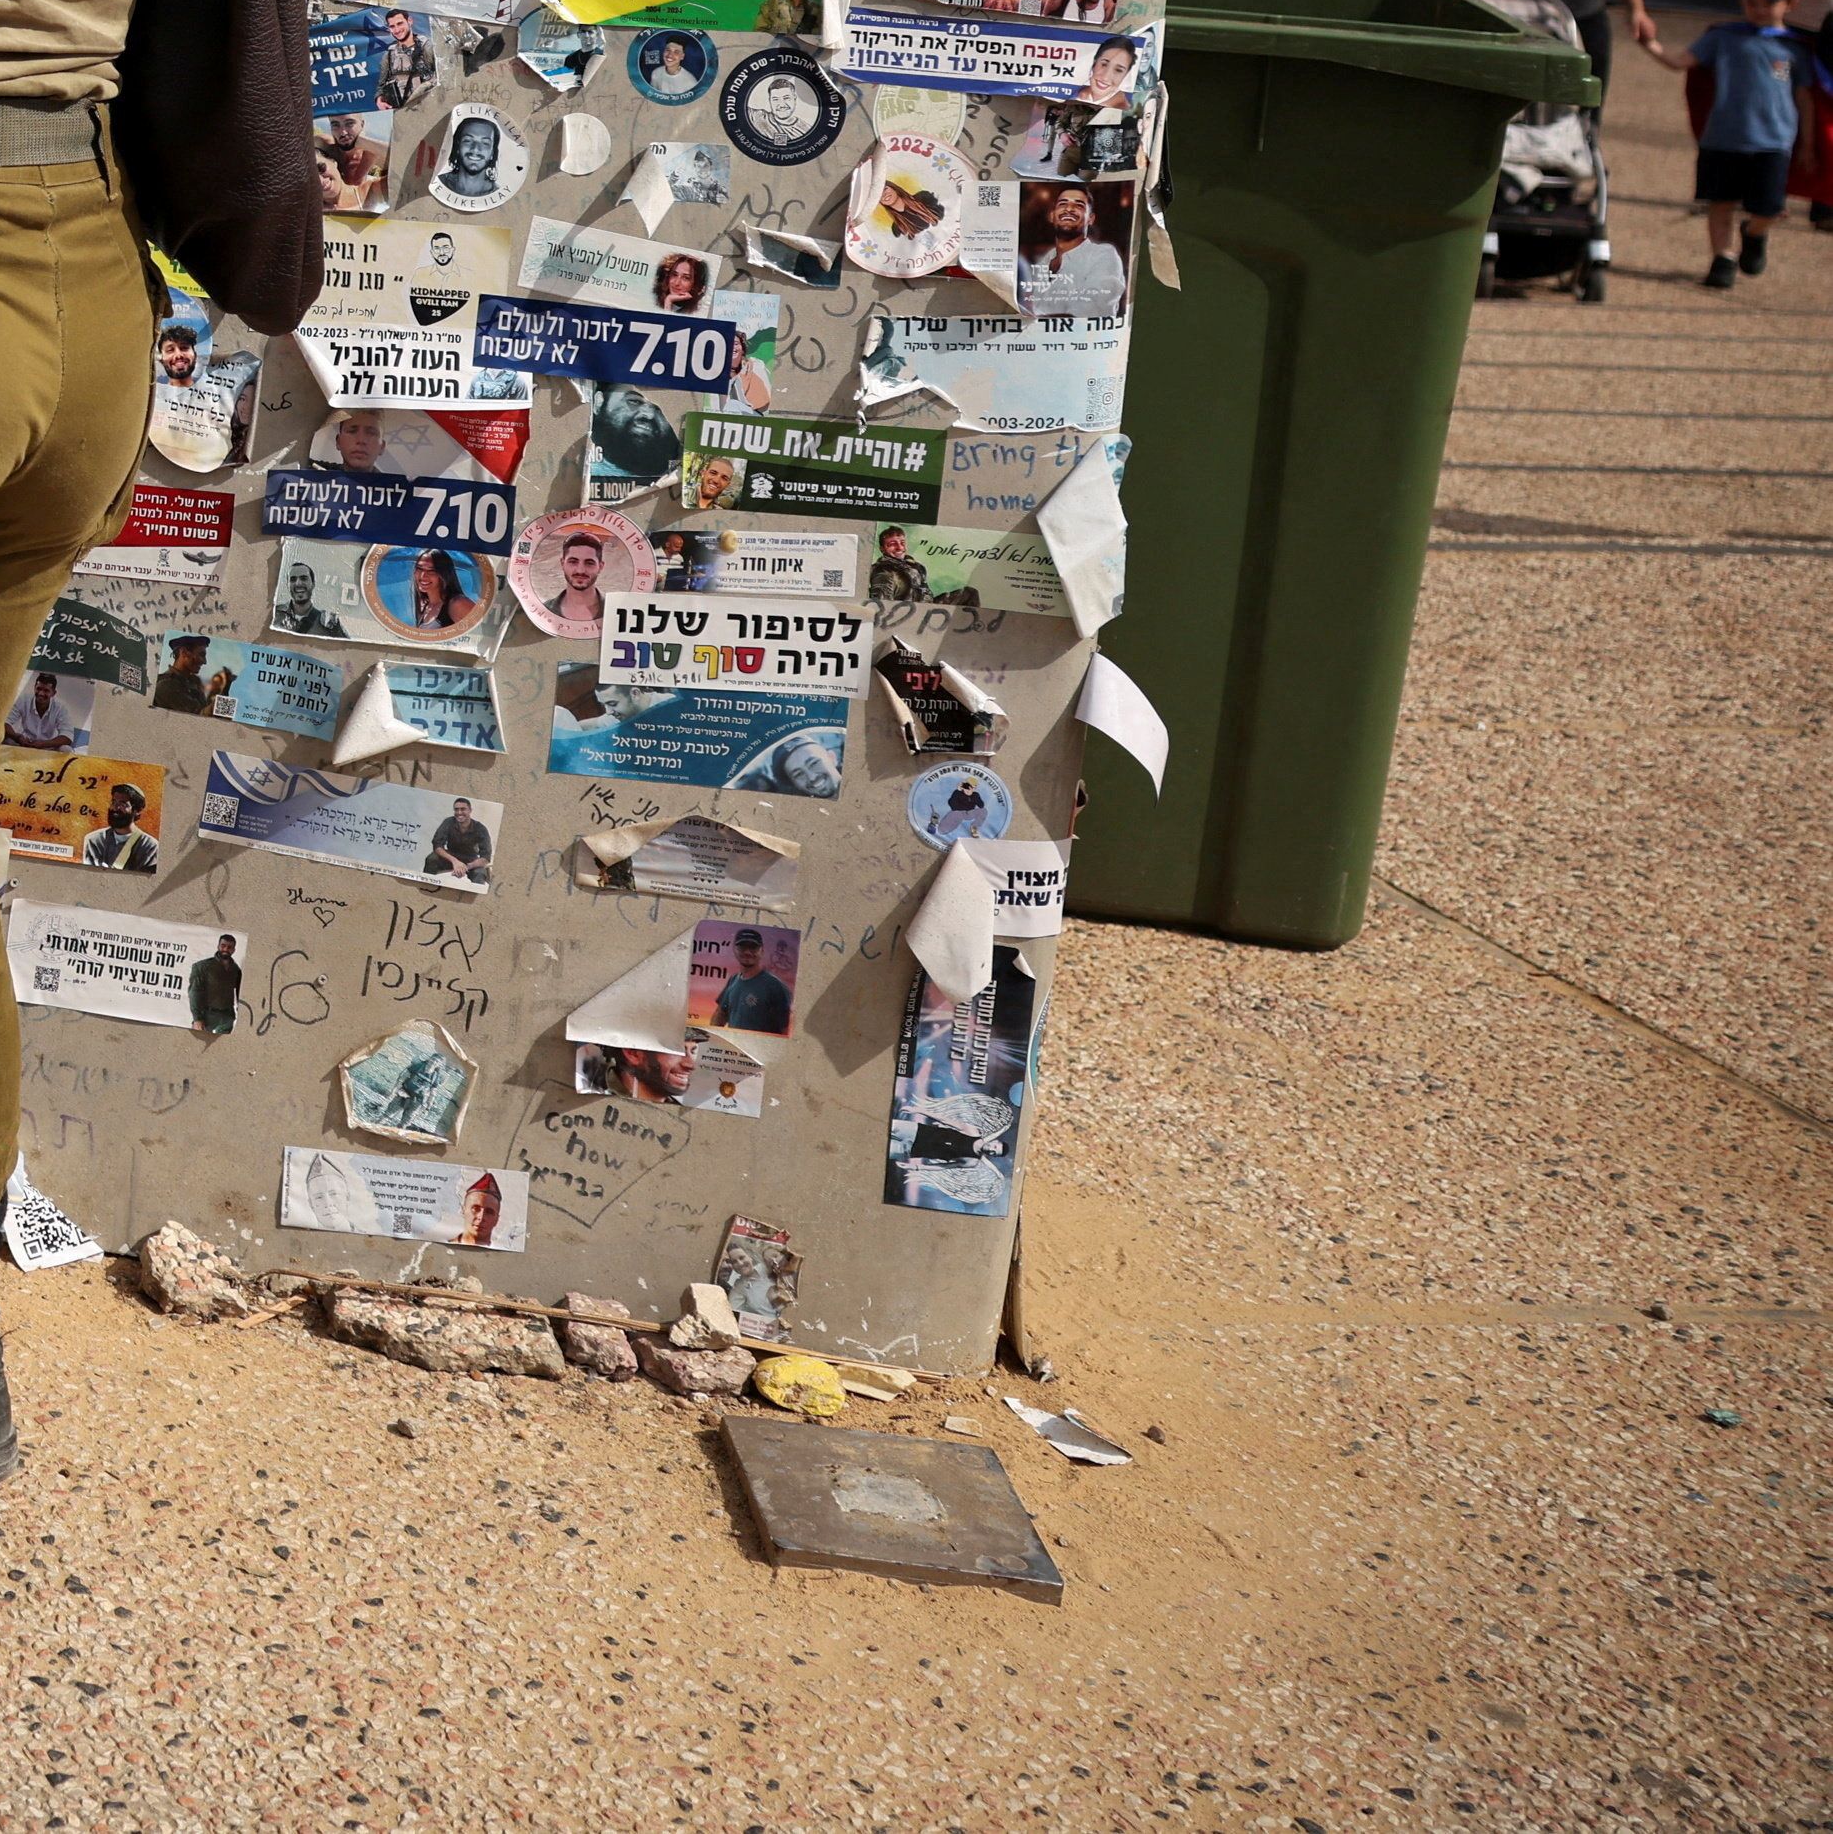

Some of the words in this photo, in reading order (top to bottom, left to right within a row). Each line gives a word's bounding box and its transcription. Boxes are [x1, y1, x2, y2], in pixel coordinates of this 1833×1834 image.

[851, 30, 913, 48] הריקוד
[947, 24, 980, 36] 7.10
[920, 36, 948, 50] את
[955, 39, 1015, 56] הפסיק
[1023, 45, 1076, 61] הטבח
[849, 48, 939, 68] הניצחון!
[947, 57, 977, 72] עד
[984, 60, 1043, 78] תעצרו
[1051, 63, 1075, 77] אל
[410, 288, 470, 298] KIDNAPPED
[498, 311, 564, 336] ולעולם
[572, 318, 623, 342] לזכור
[330, 342, 403, 367] להוביל
[481, 335, 545, 361] לשכוח
[551, 339, 579, 364] לא
[629, 321, 726, 380] 7.10
[412, 349, 460, 371] העוז
[700, 420, 927, 471] #והיית_אח_שמח
[285, 480, 349, 503] ולעולם
[356, 483, 406, 507] לזכור
[269, 505, 331, 526] לשכוח
[338, 507, 365, 529] לא
[413, 487, 508, 543] 7.10
[616, 604, 709, 636] שלנו
[727, 612, 862, 643] לסיפור
[611, 639, 680, 670] טוב
[693, 645, 762, 680] סוף
[778, 648, 860, 678] יהיה
